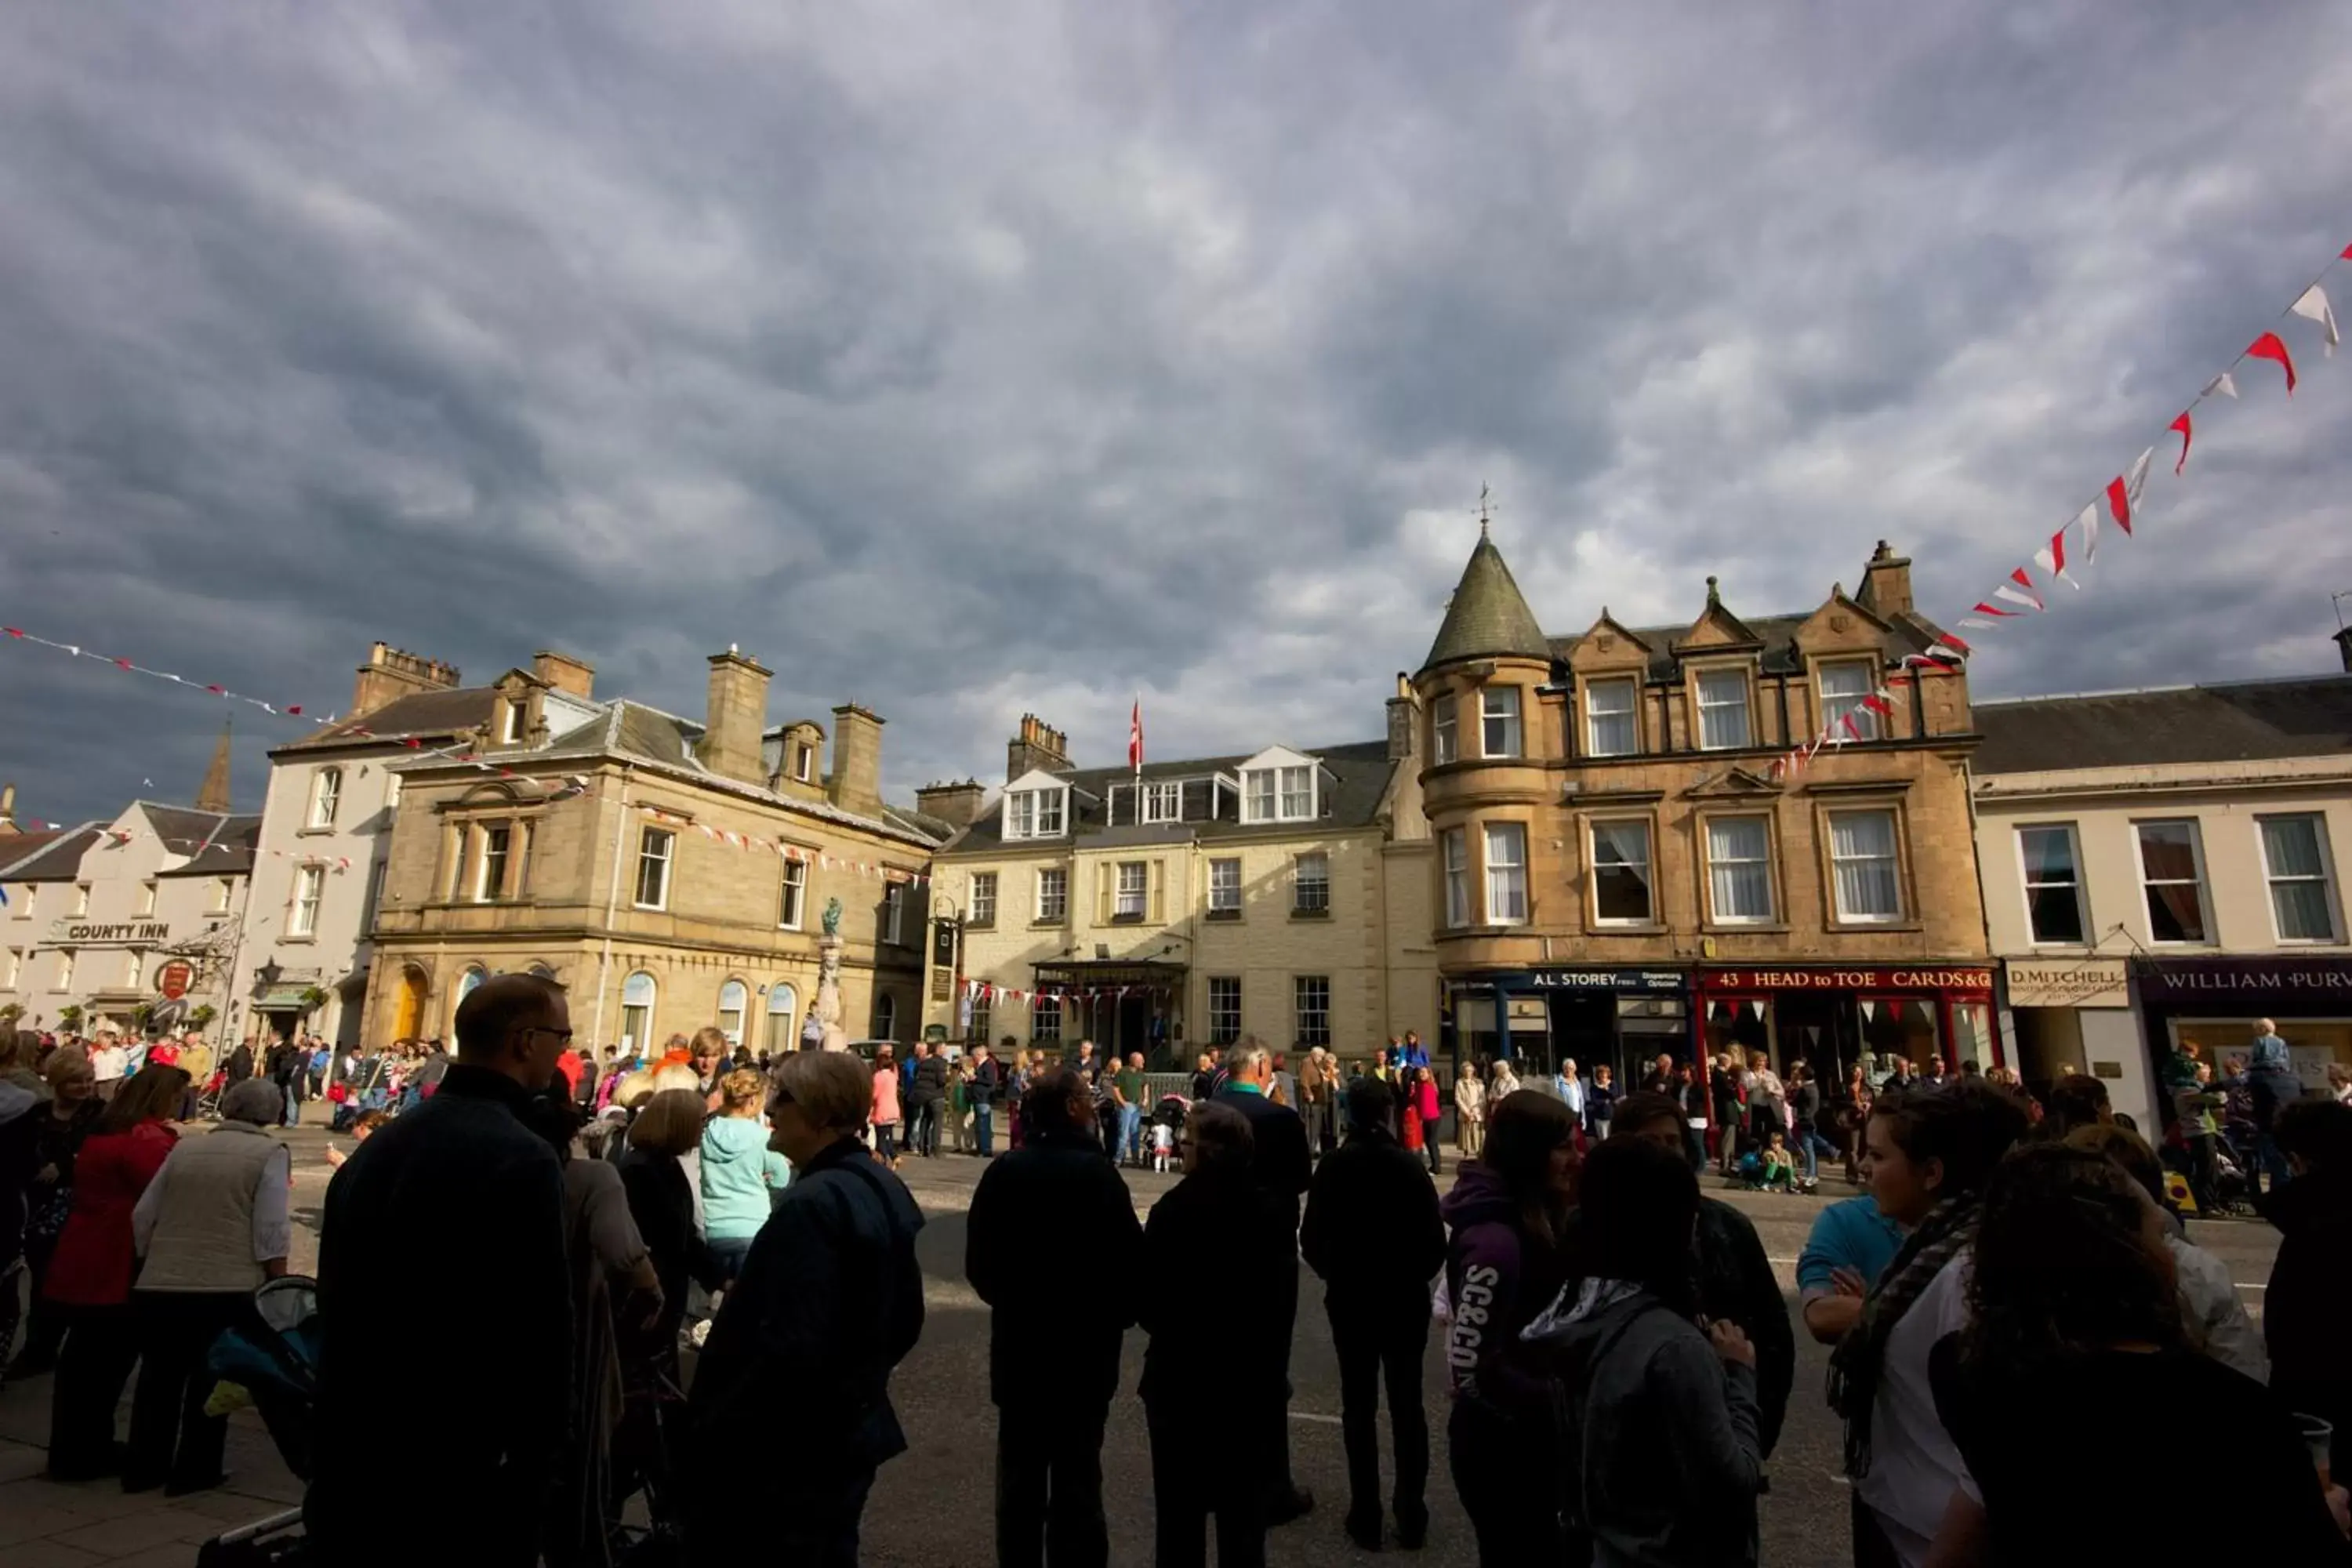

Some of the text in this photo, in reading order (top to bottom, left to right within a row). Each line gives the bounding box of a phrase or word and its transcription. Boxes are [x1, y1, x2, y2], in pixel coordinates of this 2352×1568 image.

[69, 924, 169, 939] COUNTY INN
[1561, 973, 1617, 985] STOREY
[1719, 973, 1739, 987] 43
[1755, 973, 1809, 987] HEAD
[1814, 975, 1831, 987] to
[1833, 972, 1876, 986] TOE
[2028, 970, 2115, 983] MITCHELL
[2162, 972, 2281, 989] WILLIAM
